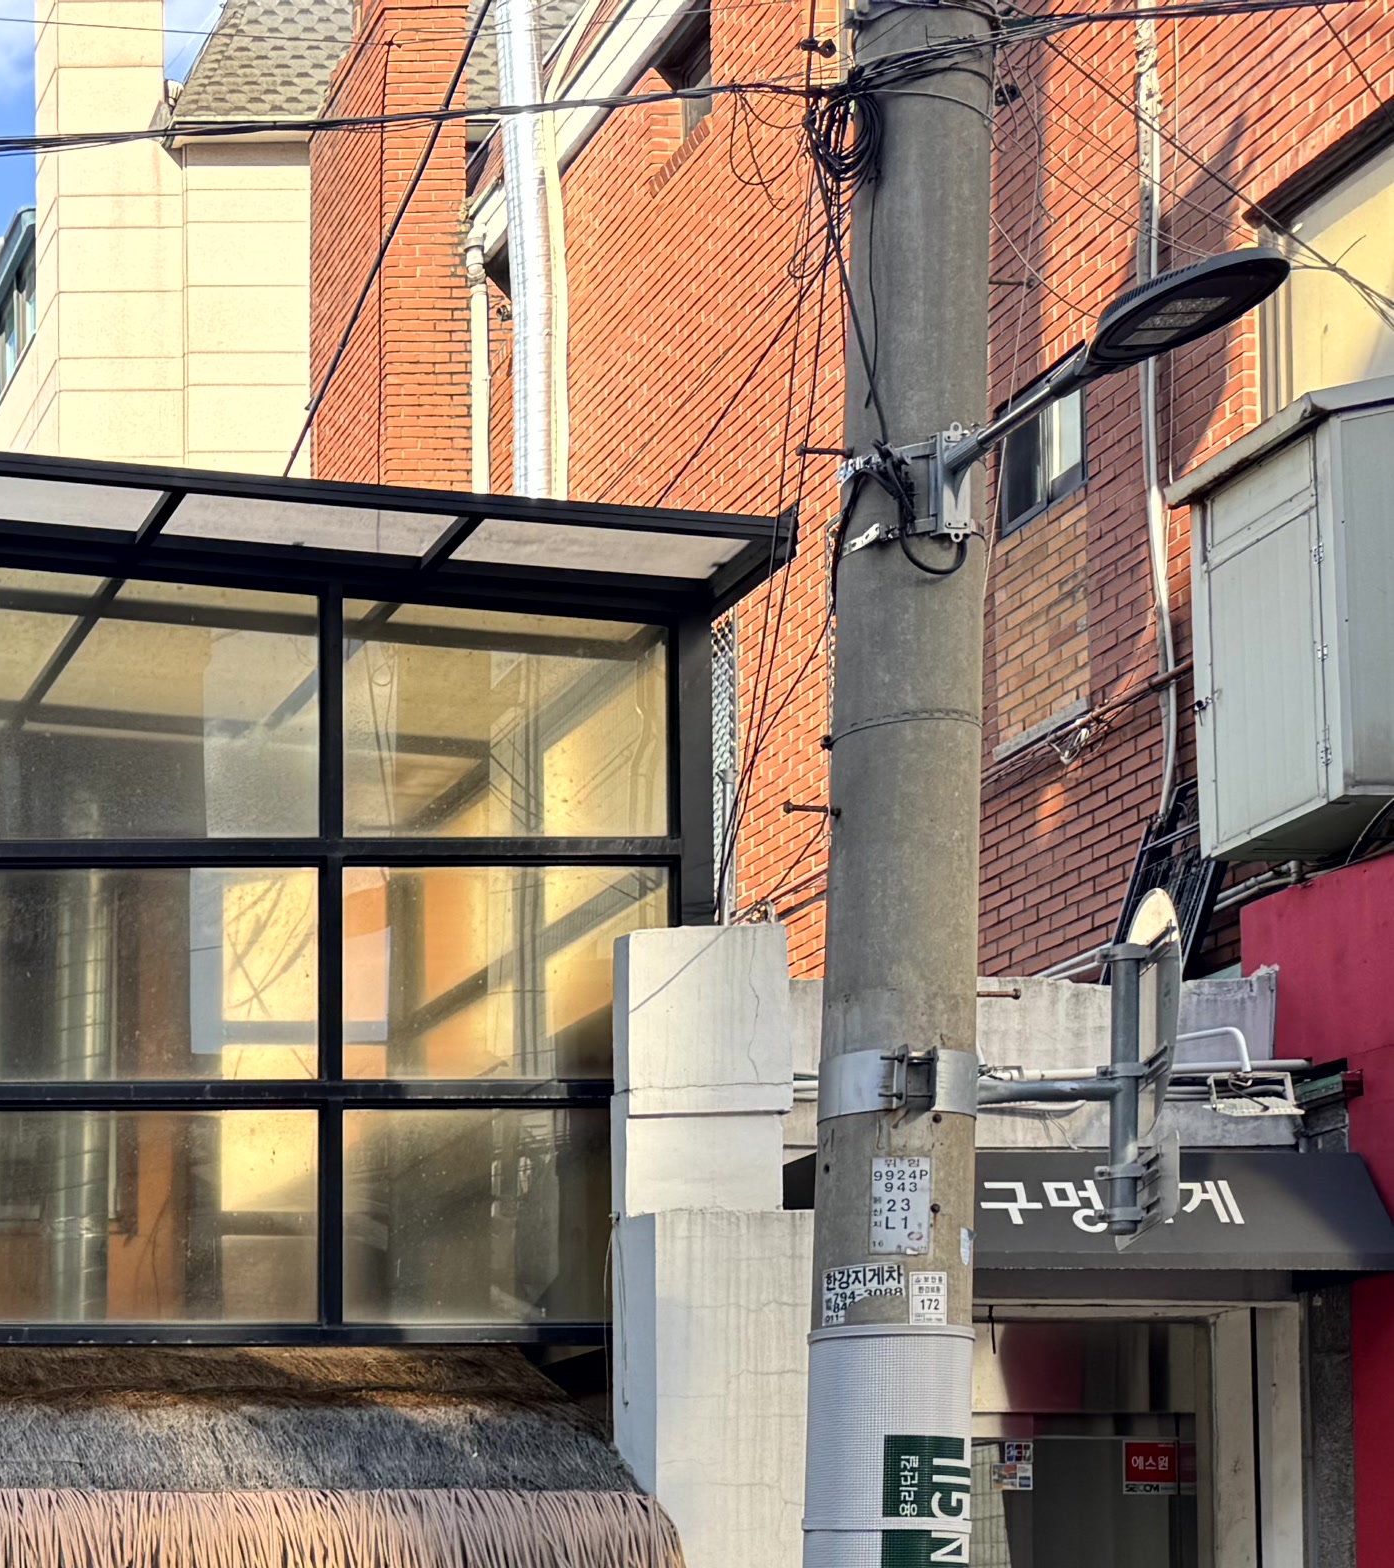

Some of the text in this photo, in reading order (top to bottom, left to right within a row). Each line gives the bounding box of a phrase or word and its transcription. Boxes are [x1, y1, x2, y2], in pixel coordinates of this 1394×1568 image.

[873, 1169, 929, 1182] 9924P
[884, 1181, 918, 1193] 943
[886, 1198, 911, 1213] 23
[980, 1179, 1246, 1233] 구멍게
[824, 1265, 904, 1292] 한강지게차
[920, 1299, 940, 1311] 172
[1130, 1455, 1169, 1471] 에스원
[899, 1455, 919, 1518] 용리단길
